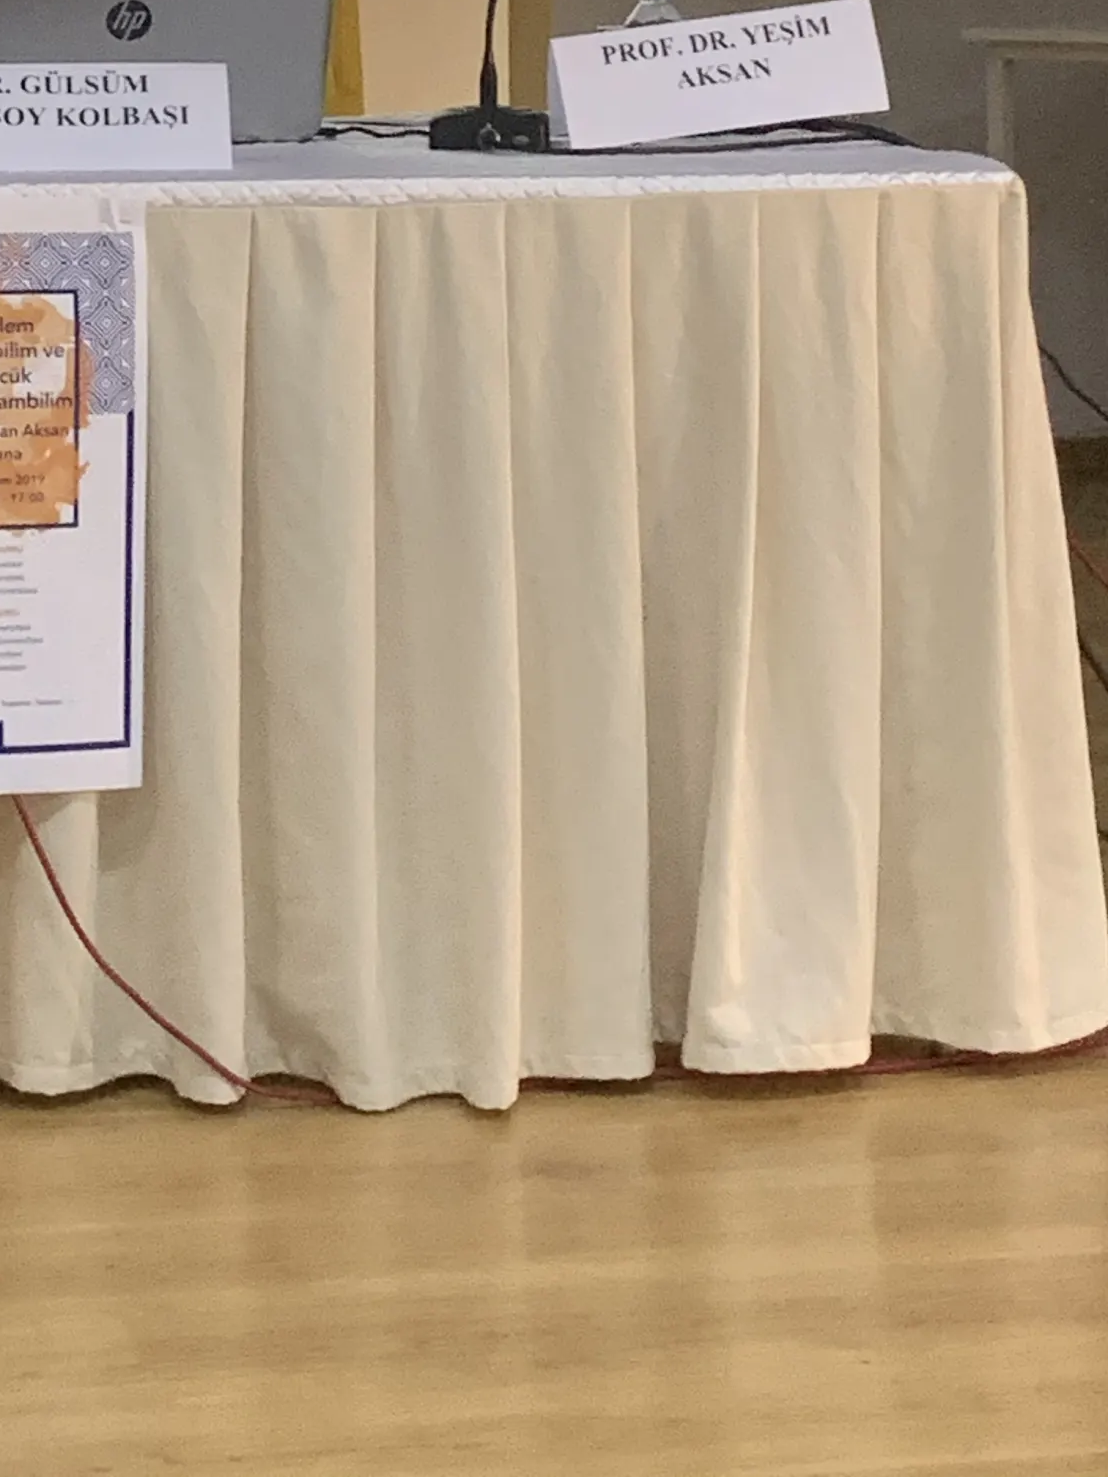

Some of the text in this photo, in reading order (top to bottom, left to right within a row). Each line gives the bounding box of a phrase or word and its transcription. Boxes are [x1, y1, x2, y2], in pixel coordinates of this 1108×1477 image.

[601, 15, 832, 65] PROF. DR. YEŞİM
[20, 70, 149, 95] GÜLSÜM
[678, 58, 773, 89] AKSAN
[56, 105, 190, 129] KOLBAŞI
[43, 346, 65, 357] ve
